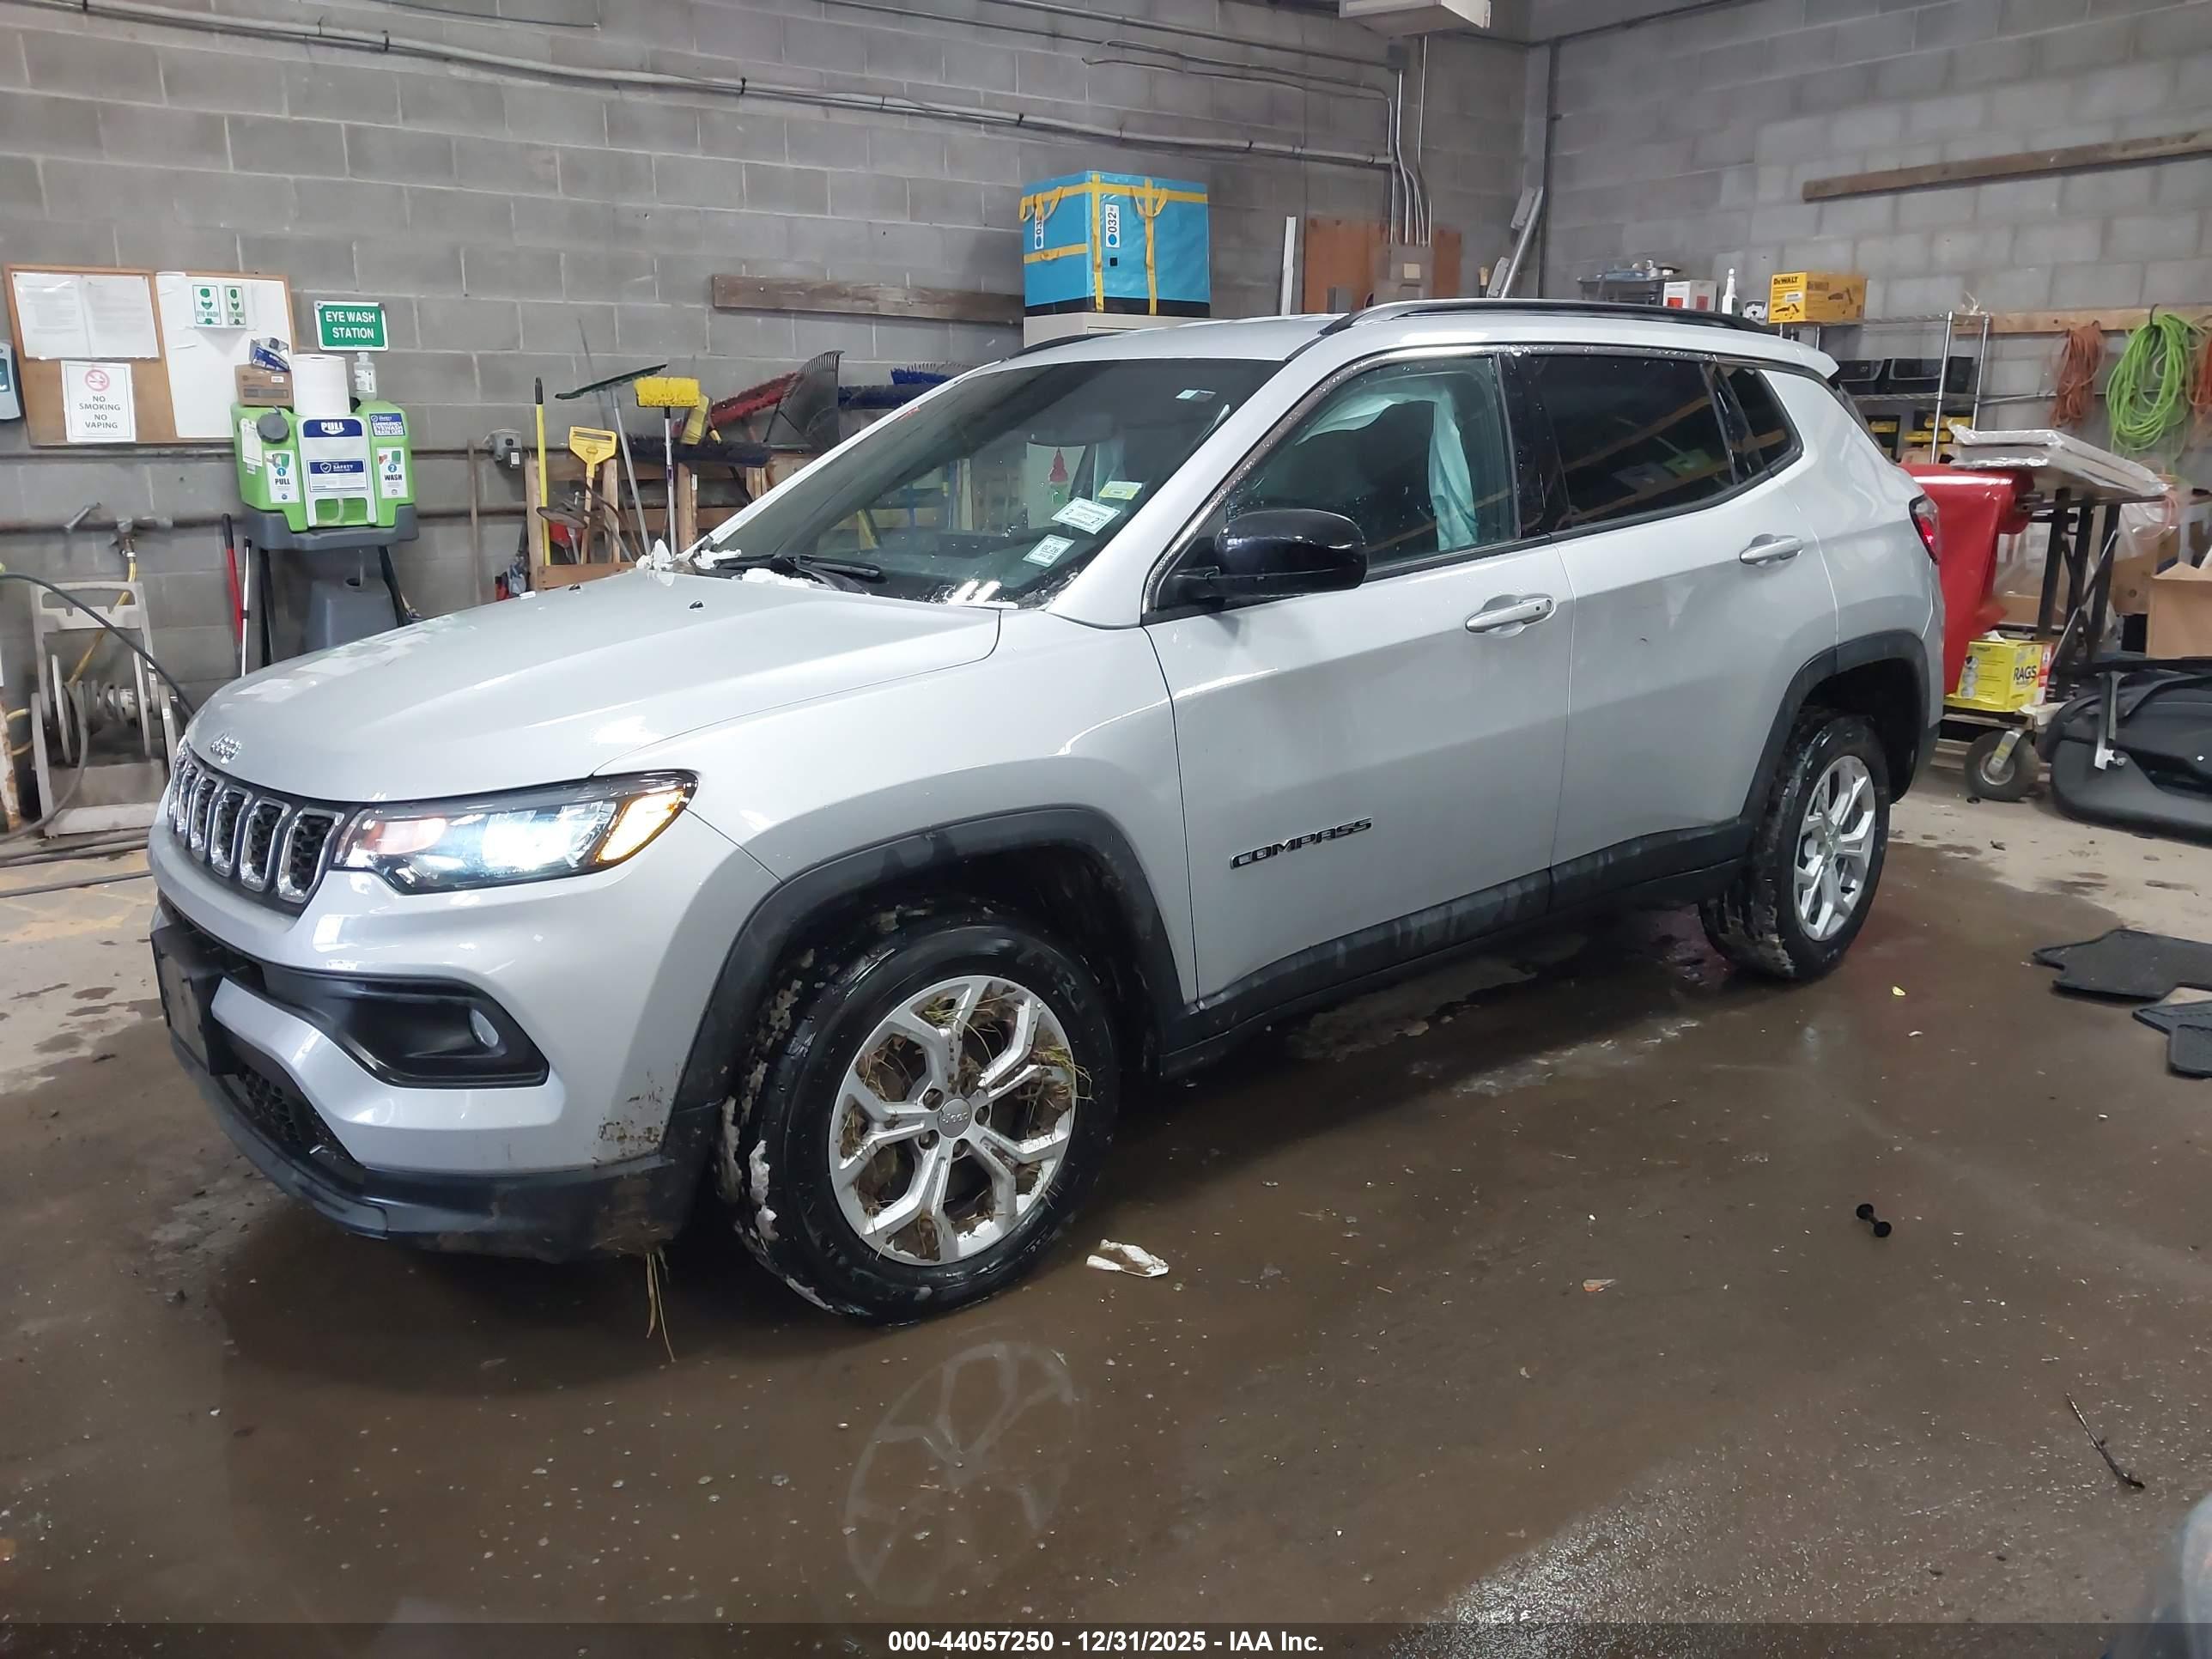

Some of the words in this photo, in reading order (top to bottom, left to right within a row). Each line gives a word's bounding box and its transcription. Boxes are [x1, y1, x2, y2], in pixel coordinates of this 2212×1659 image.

[1107, 212, 1117, 233] 032
[325, 311, 345, 323] EYE
[345, 311, 376, 323] WASH
[331, 326, 375, 339] STATION
[79, 403, 121, 411] SMOKING
[85, 421, 118, 429] VAPING
[320, 422, 344, 431] PULL
[2013, 665, 2037, 681] RAGS
[1230, 817, 1372, 869] COMPASS
